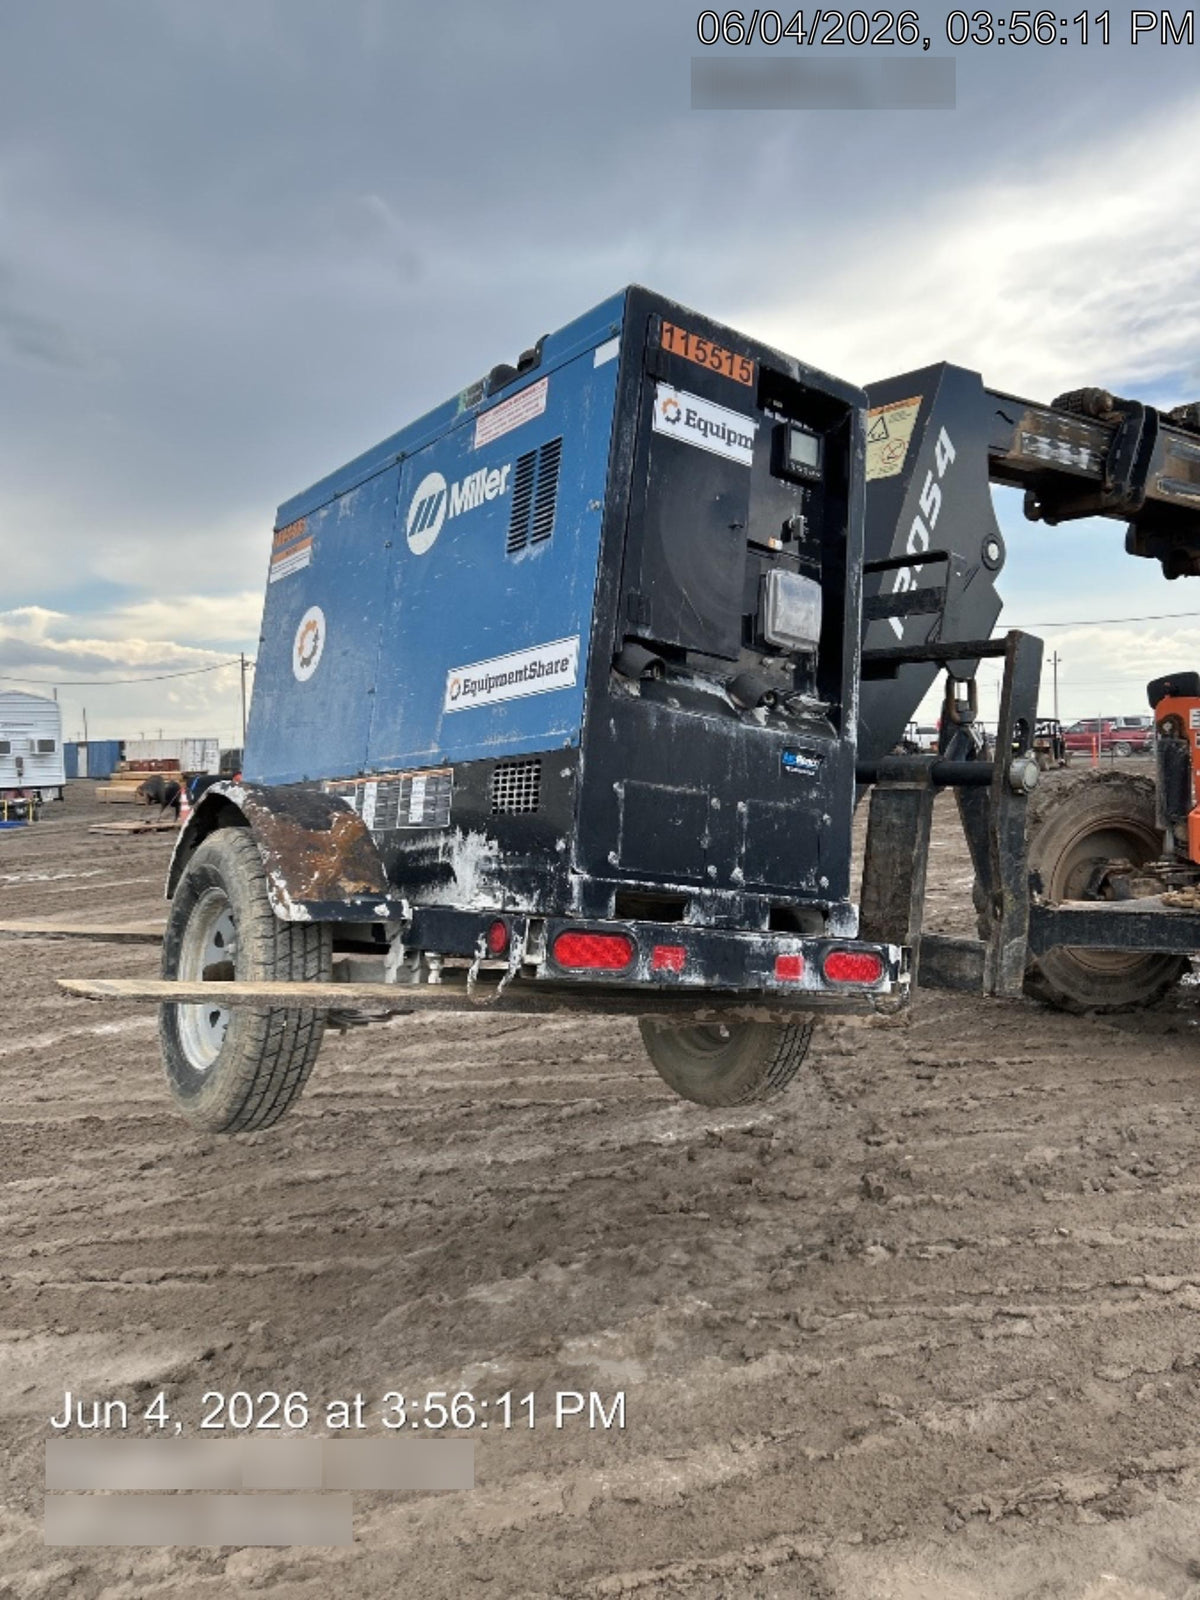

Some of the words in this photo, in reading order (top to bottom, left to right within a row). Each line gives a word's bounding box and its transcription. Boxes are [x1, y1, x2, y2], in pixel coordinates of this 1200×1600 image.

[664, 325, 753, 384] 115515
[447, 463, 512, 520] Miller
[461, 656, 571, 697] EquipmentShare
